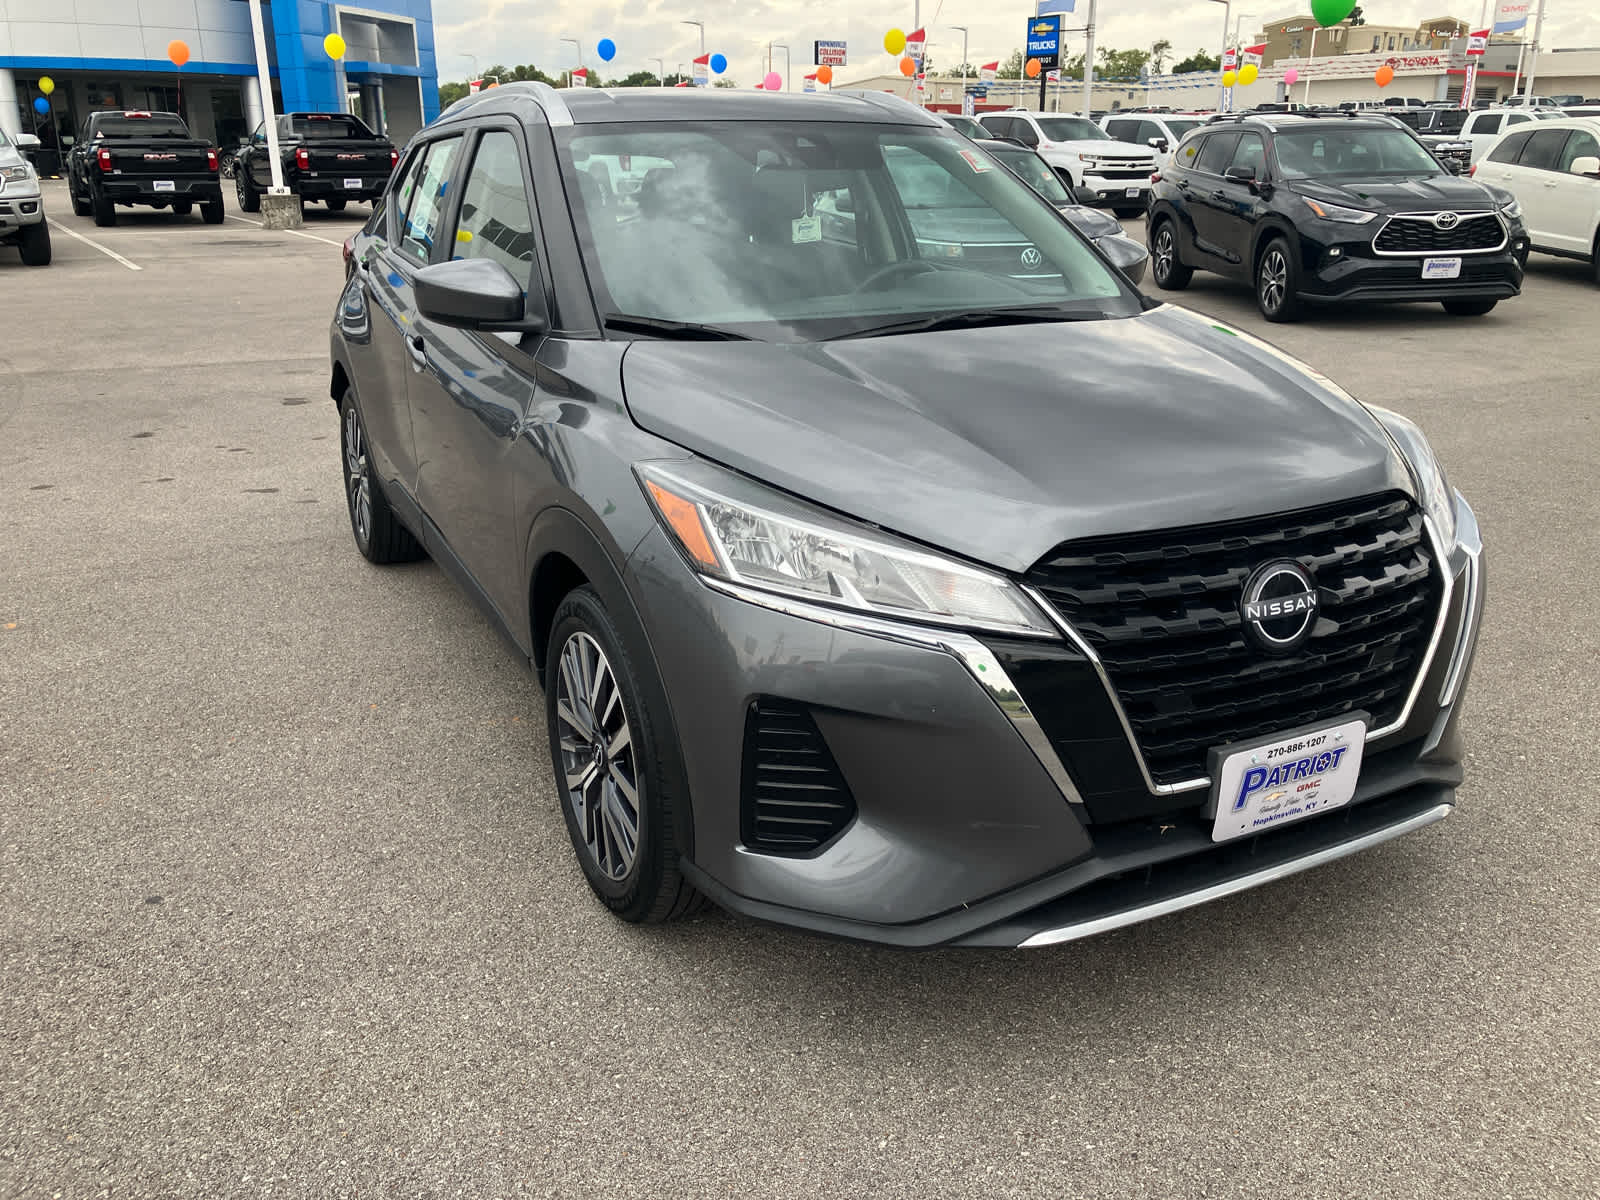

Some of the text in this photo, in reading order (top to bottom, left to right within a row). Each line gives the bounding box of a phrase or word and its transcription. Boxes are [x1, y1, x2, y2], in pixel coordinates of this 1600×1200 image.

[819, 48, 846, 56] COLLISION
[1028, 40, 1056, 50] TRUCKS
[822, 56, 843, 64] CENTER
[1402, 56, 1440, 67] TOYOTA
[1247, 593, 1317, 619] NISSAN
[1267, 735, 1327, 760] 270-886-1207
[1232, 745, 1349, 813] PATRIOT
[1296, 779, 1322, 793] GMC
[1252, 807, 1303, 827] Hopkinsville,
[1305, 801, 1318, 811] KY
